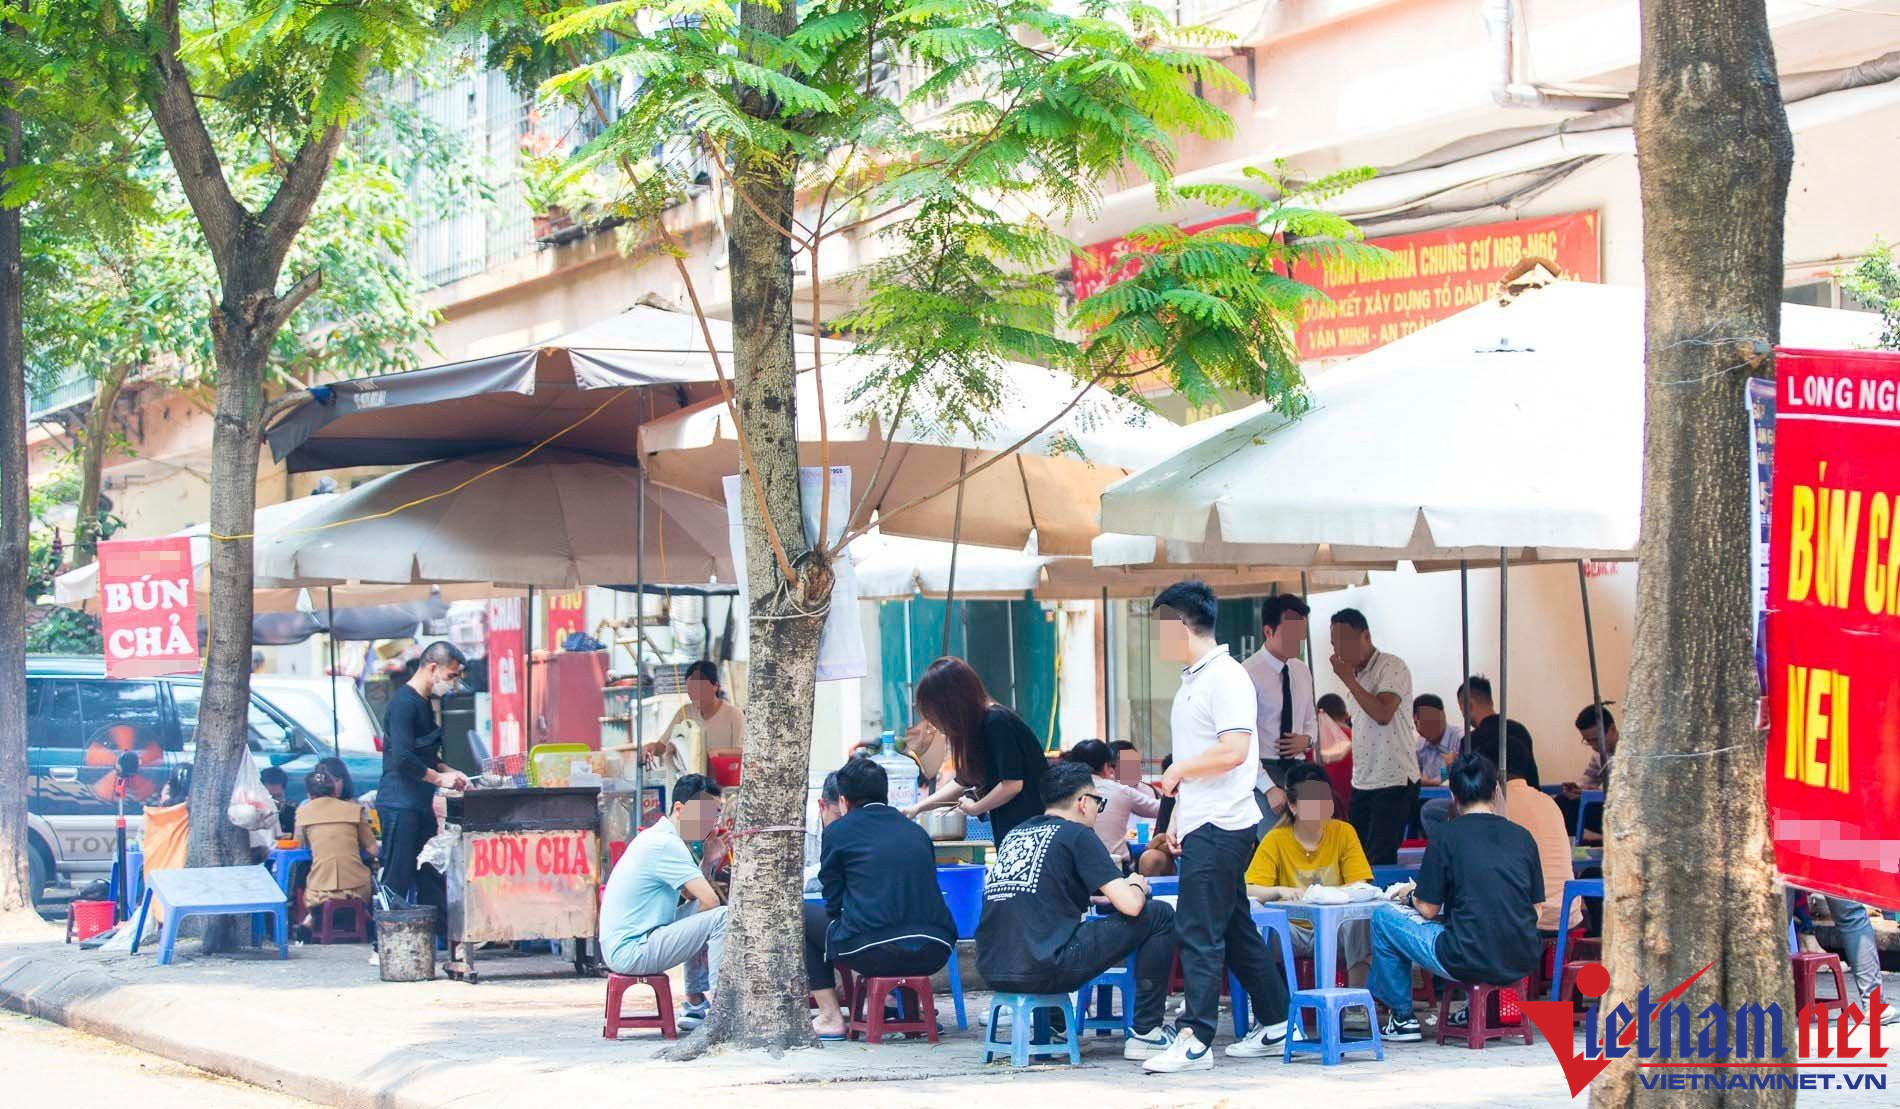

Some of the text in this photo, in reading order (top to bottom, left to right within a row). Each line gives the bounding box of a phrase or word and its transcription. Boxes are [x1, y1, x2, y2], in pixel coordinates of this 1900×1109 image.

[1420, 242, 1467, 276] CHUNG
[1470, 235, 1491, 270] CƯ
[1364, 289, 1391, 315] XÂY
[1454, 280, 1484, 305] DÂN
[1338, 326, 1370, 346] MINH
[1787, 375, 1853, 409] LONG
[1859, 379, 1900, 412] NG
[1788, 461, 1862, 609] BÚN
[104, 574, 189, 613] BÚN
[108, 612, 195, 659] CHẢ
[65, 836, 117, 853] TOY
